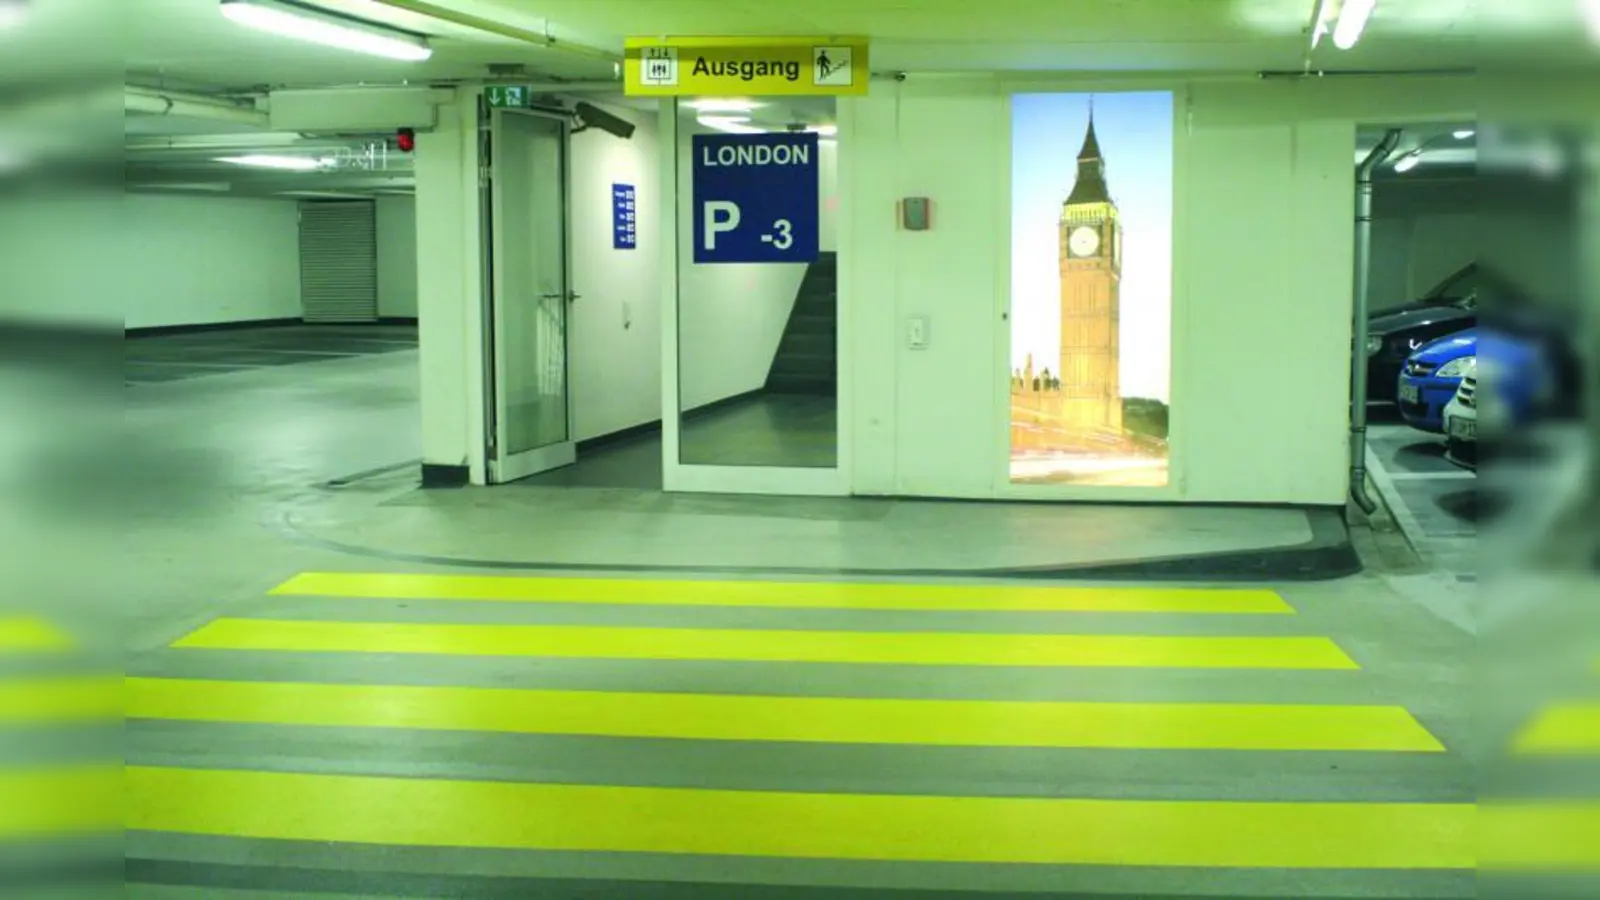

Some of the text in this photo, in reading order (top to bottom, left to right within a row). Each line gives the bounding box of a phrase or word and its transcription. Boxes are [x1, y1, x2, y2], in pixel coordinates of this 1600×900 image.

[692, 56, 800, 80] Ausgang
[703, 144, 809, 166] LONDON
[704, 200, 793, 250] P -3
